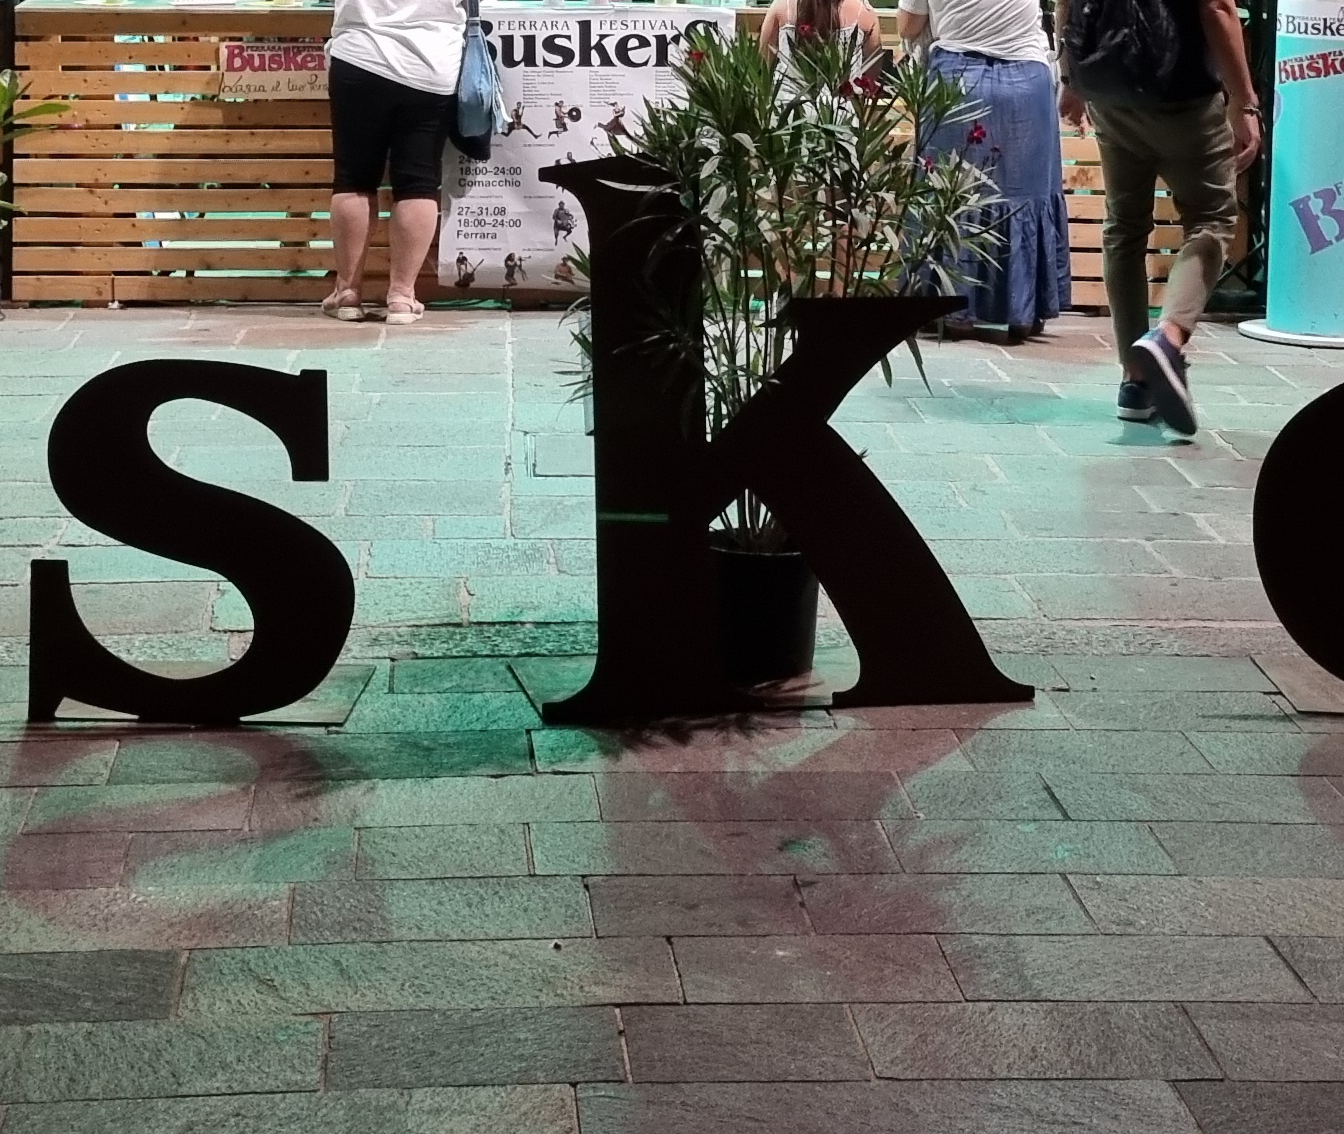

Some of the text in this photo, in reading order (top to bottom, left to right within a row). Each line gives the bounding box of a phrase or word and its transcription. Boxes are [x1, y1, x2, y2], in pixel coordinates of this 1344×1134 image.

[498, 19, 676, 31] FERRARA FESTIVAL
[225, 44, 327, 72] Busker
[458, 177, 521, 188] Comacchio
[456, 229, 498, 240] Ferrara
